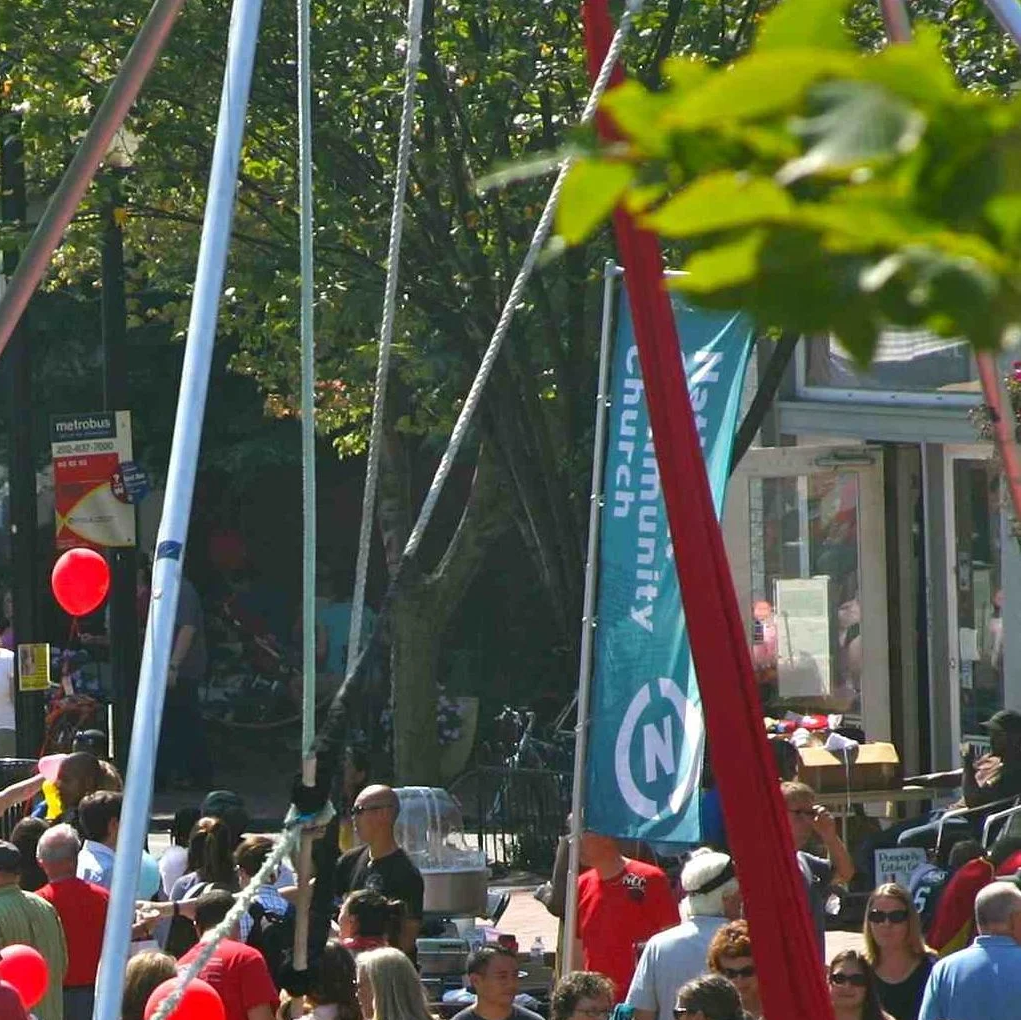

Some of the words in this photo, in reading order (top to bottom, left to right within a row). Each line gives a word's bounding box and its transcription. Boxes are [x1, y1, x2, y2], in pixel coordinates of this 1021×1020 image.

[55, 417, 111, 432] metrobus
[613, 344, 648, 519] Church
[631, 426, 663, 633] munity
[643, 714, 676, 783] N
